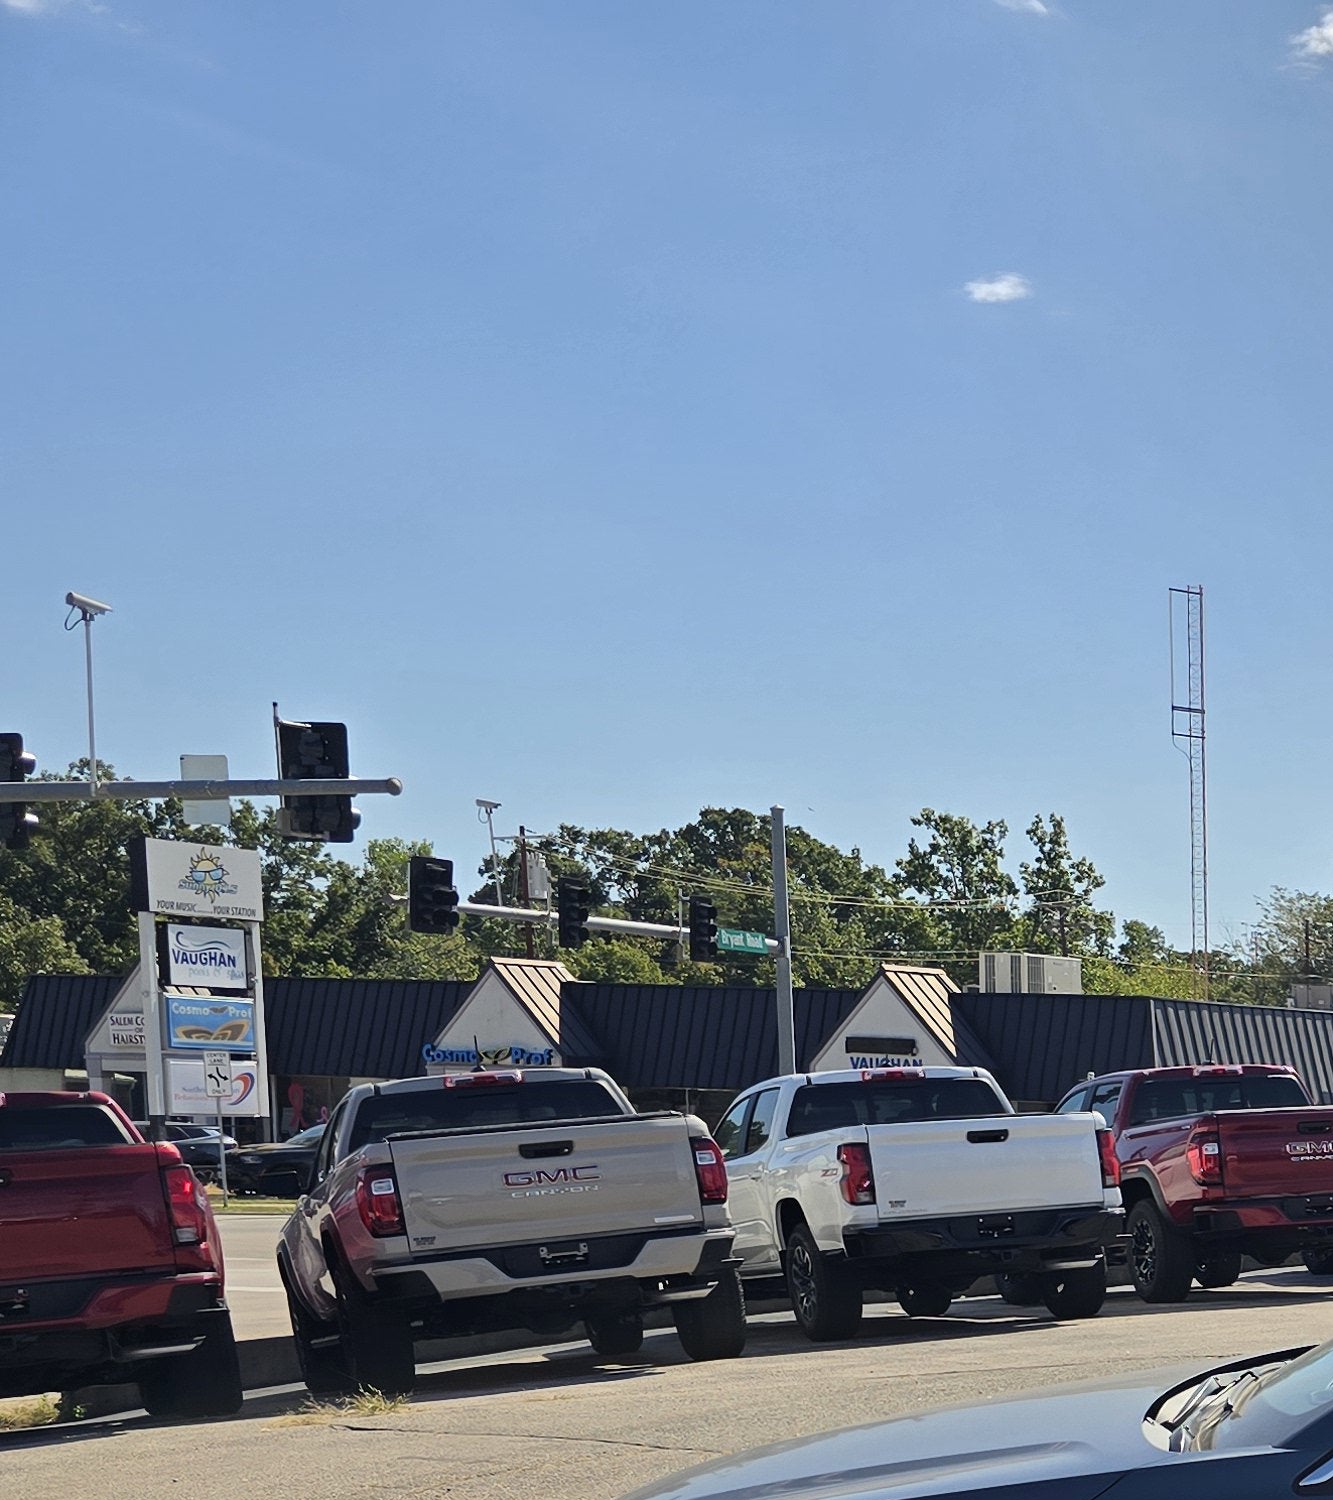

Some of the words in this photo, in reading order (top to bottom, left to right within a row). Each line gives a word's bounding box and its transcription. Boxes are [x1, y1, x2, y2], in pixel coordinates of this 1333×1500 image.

[156, 900, 175, 910] YOUR
[231, 907, 256, 917] STATION
[721, 929, 745, 948] Bryant
[745, 932, 763, 948] Road
[172, 948, 236, 968] VAUGHAN
[171, 1002, 210, 1016] Cosmo
[227, 1005, 252, 1018] Prof
[110, 1015, 133, 1026] SALEM
[422, 1043, 477, 1063] Cosmo
[511, 1046, 553, 1065] Prof
[503, 1165, 601, 1189] GMC
